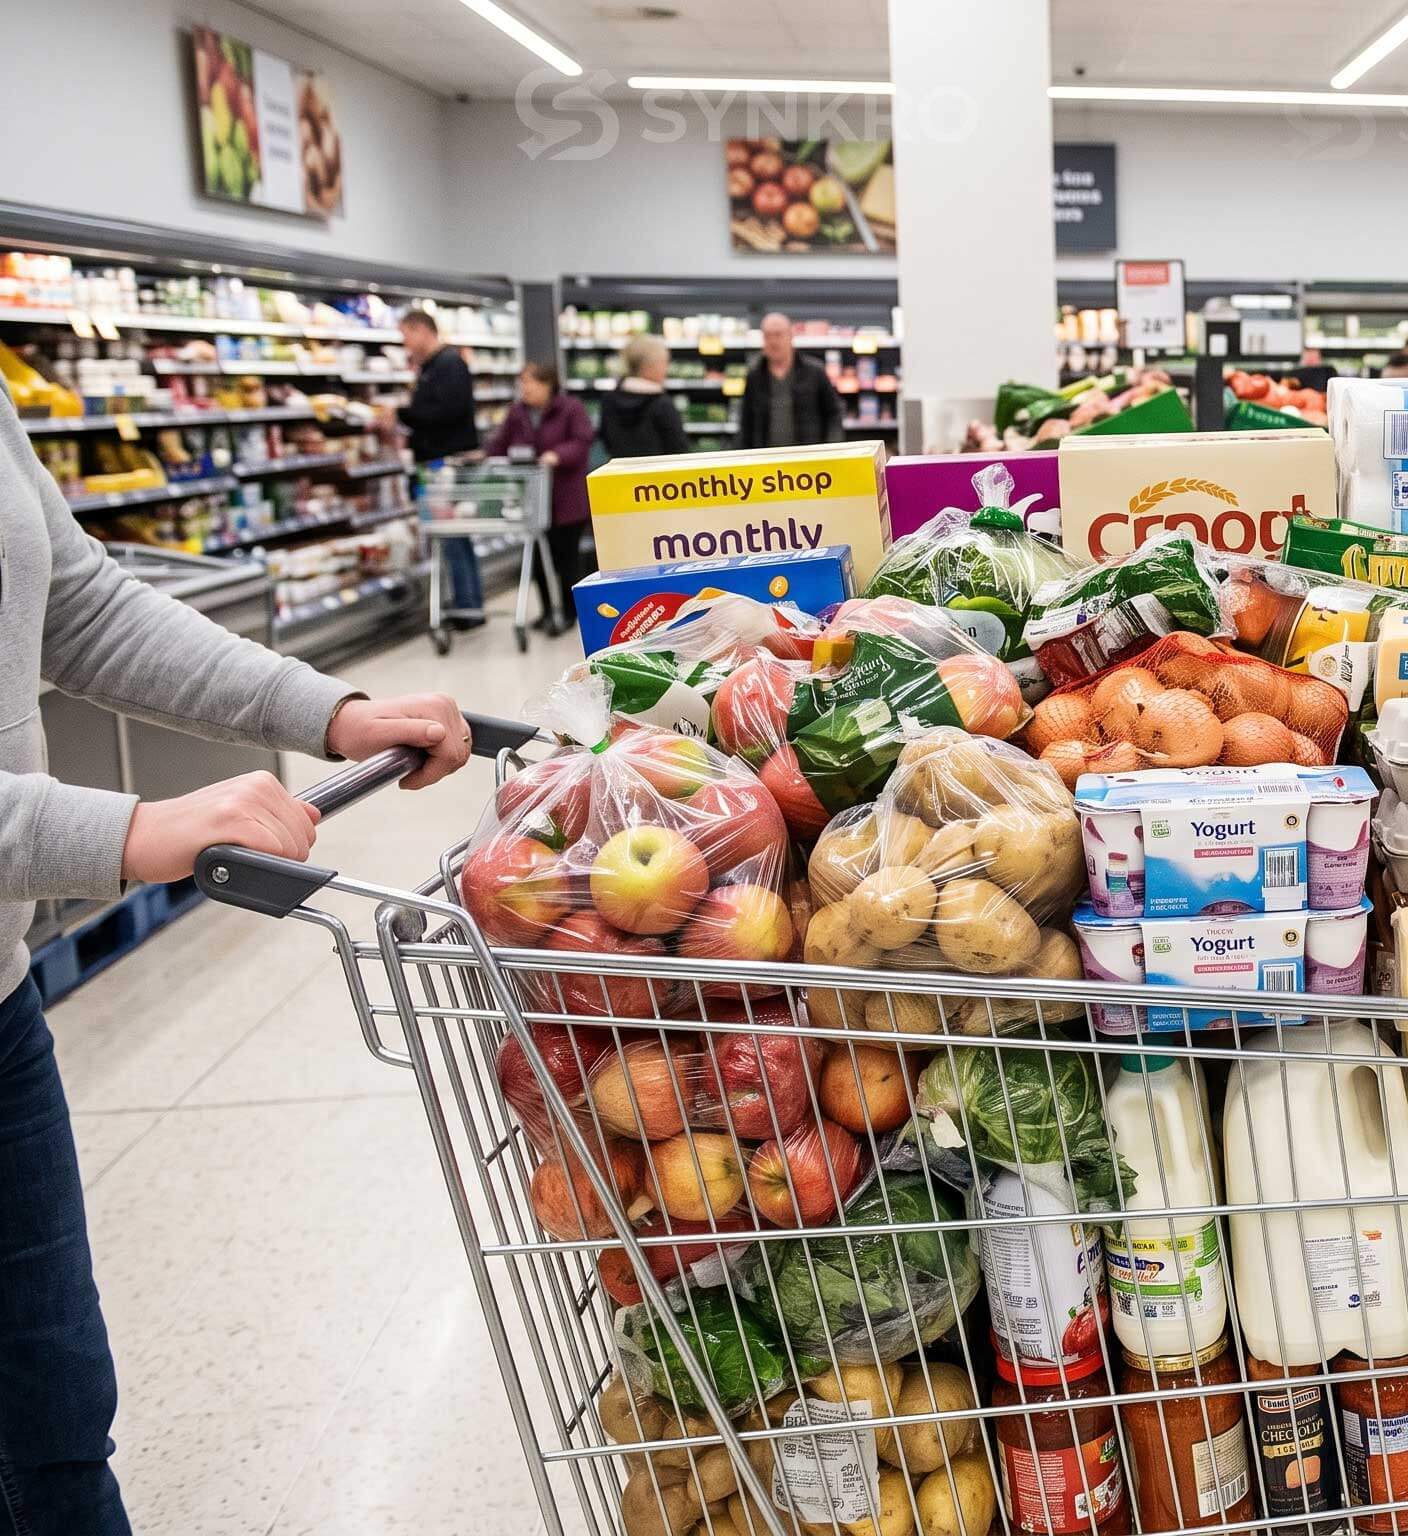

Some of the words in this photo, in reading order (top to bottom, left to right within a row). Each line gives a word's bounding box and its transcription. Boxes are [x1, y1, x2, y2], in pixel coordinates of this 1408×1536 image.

[633, 473, 755, 502] monthly
[762, 469, 833, 496] shop
[652, 516, 824, 561] monthly
[1190, 819, 1257, 841] Yogurt
[1190, 935, 1256, 956] Yogurt
